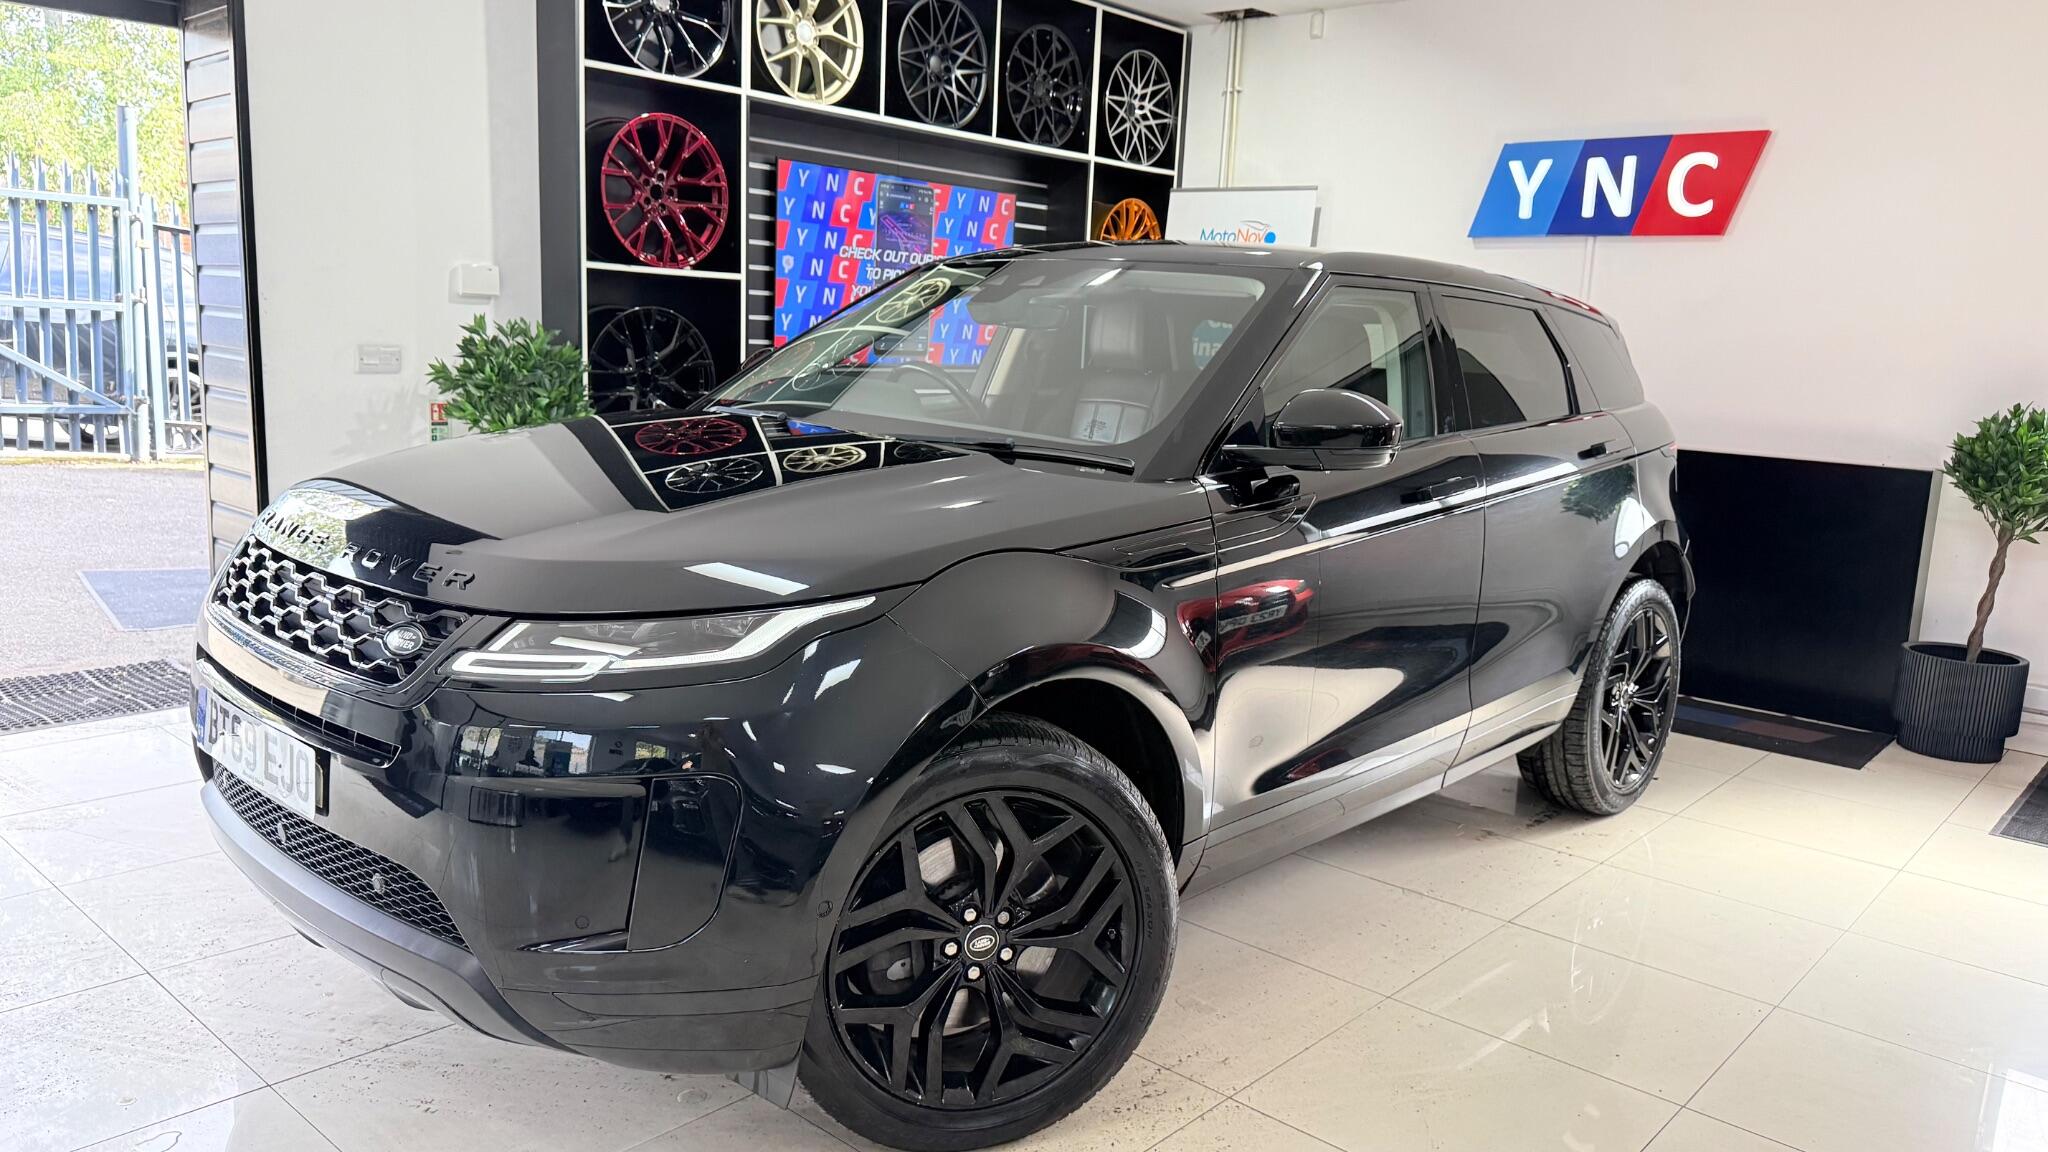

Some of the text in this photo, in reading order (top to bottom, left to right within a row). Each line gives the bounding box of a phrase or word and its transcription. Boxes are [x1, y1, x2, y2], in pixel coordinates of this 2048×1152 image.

[799, 169, 865, 195] YNC
[1508, 151, 1719, 220] YNC
[784, 197, 852, 223] YNC
[956, 192, 1010, 215] YNC
[944, 217, 999, 240] YNC
[839, 245, 882, 261] CHECK
[883, 250, 909, 263] OUT
[866, 264, 881, 280] TO
[261, 508, 476, 592] RANGE ROVER
